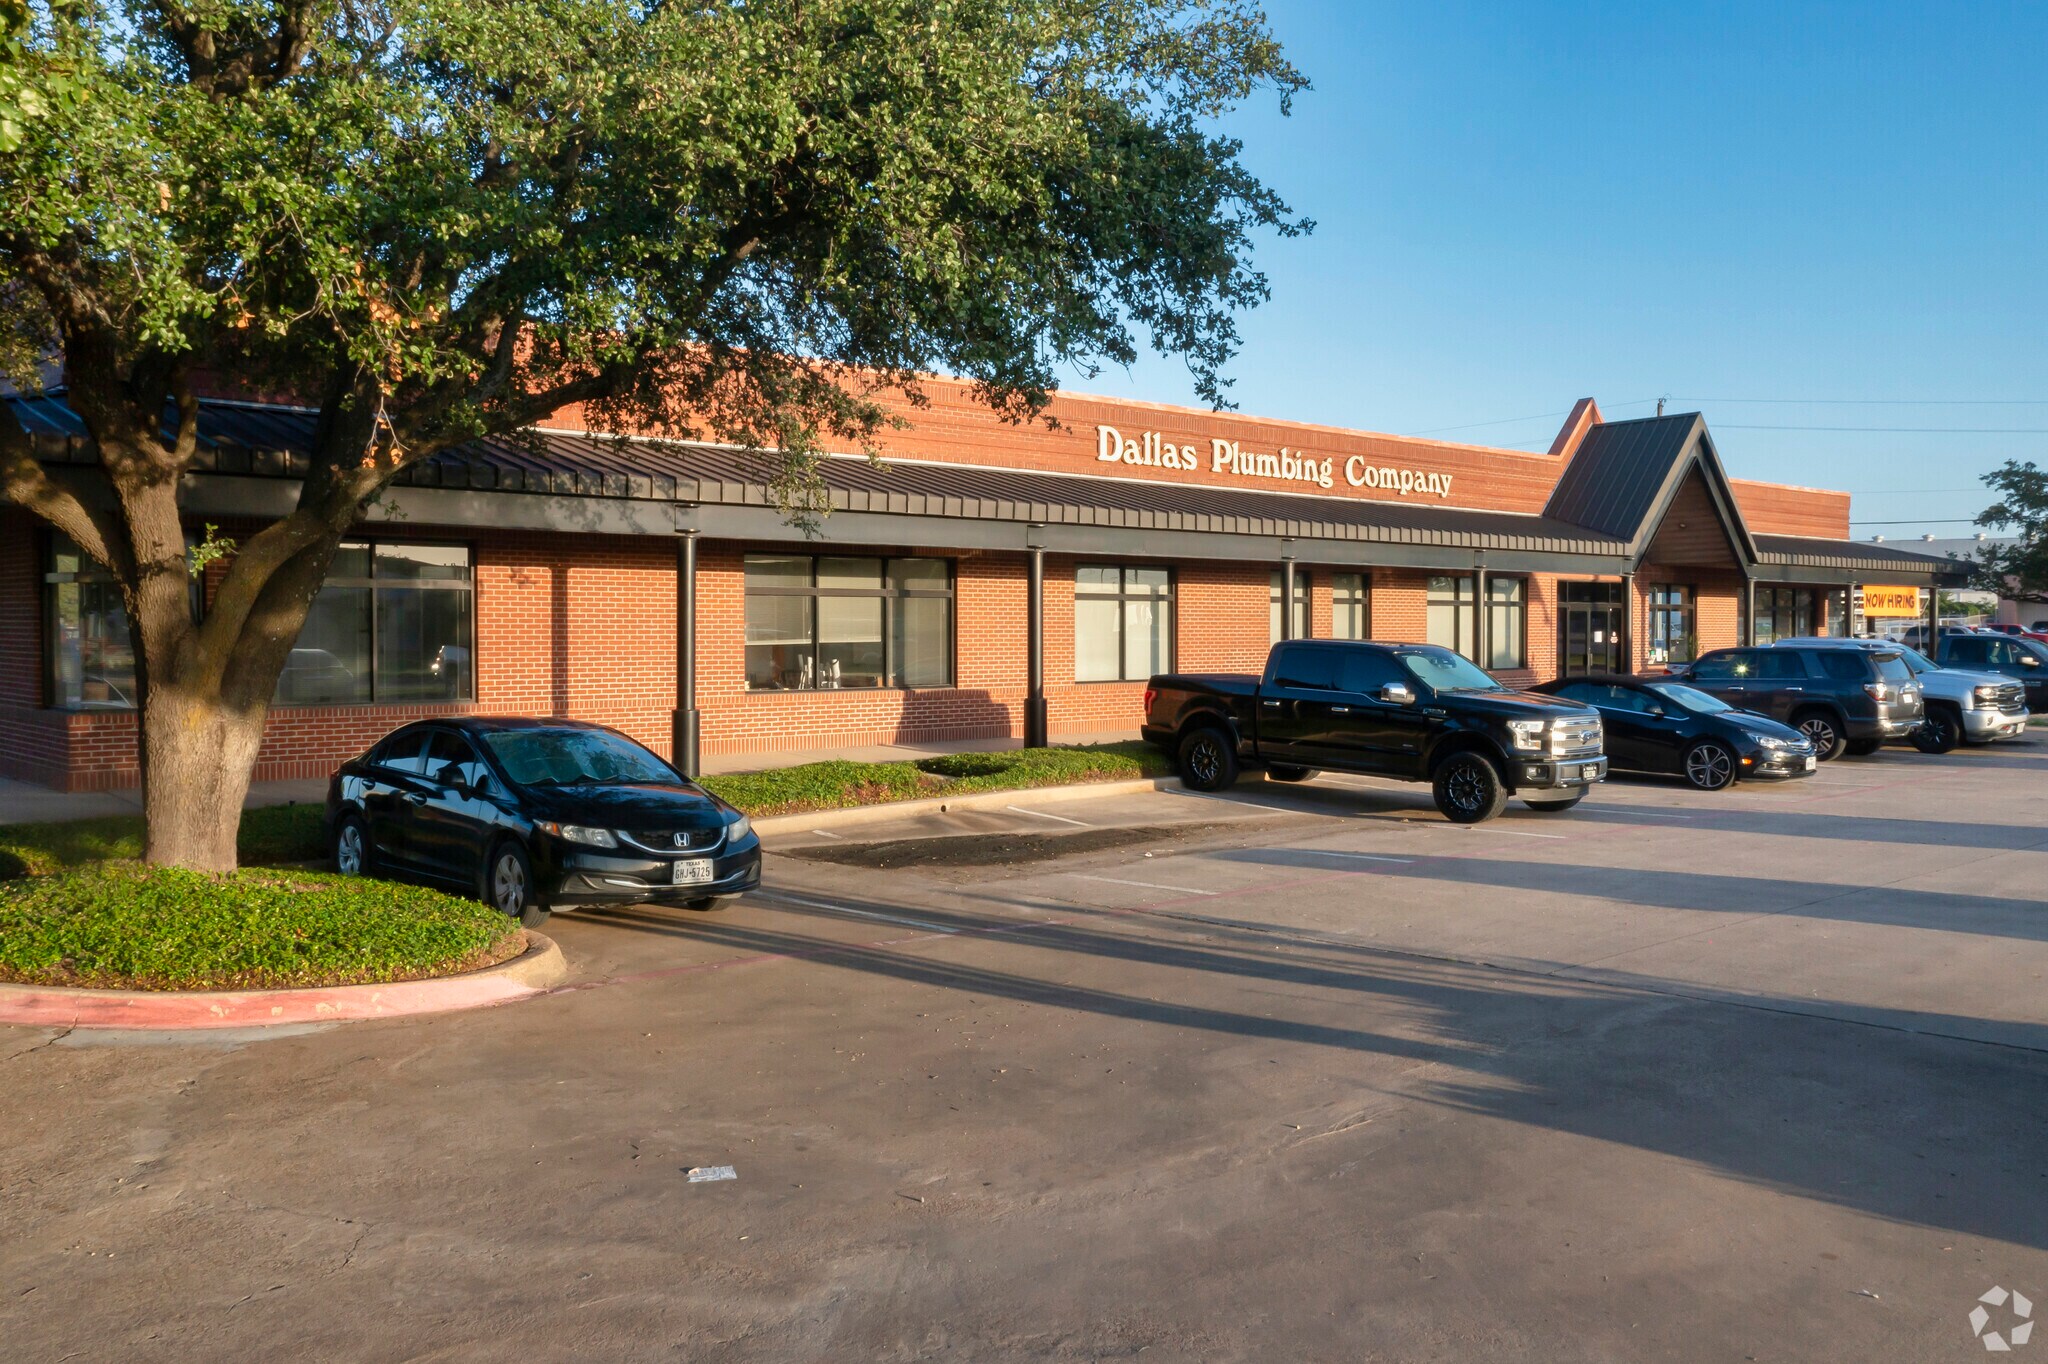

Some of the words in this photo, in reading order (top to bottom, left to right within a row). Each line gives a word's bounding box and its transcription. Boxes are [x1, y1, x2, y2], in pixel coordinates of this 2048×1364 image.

[1096, 425, 1198, 471] Dallas
[1210, 438, 1334, 488] Plumbing
[1345, 455, 1454, 498] Company
[1865, 593, 1886, 608] NOW
[1887, 594, 1914, 608] HIRING
